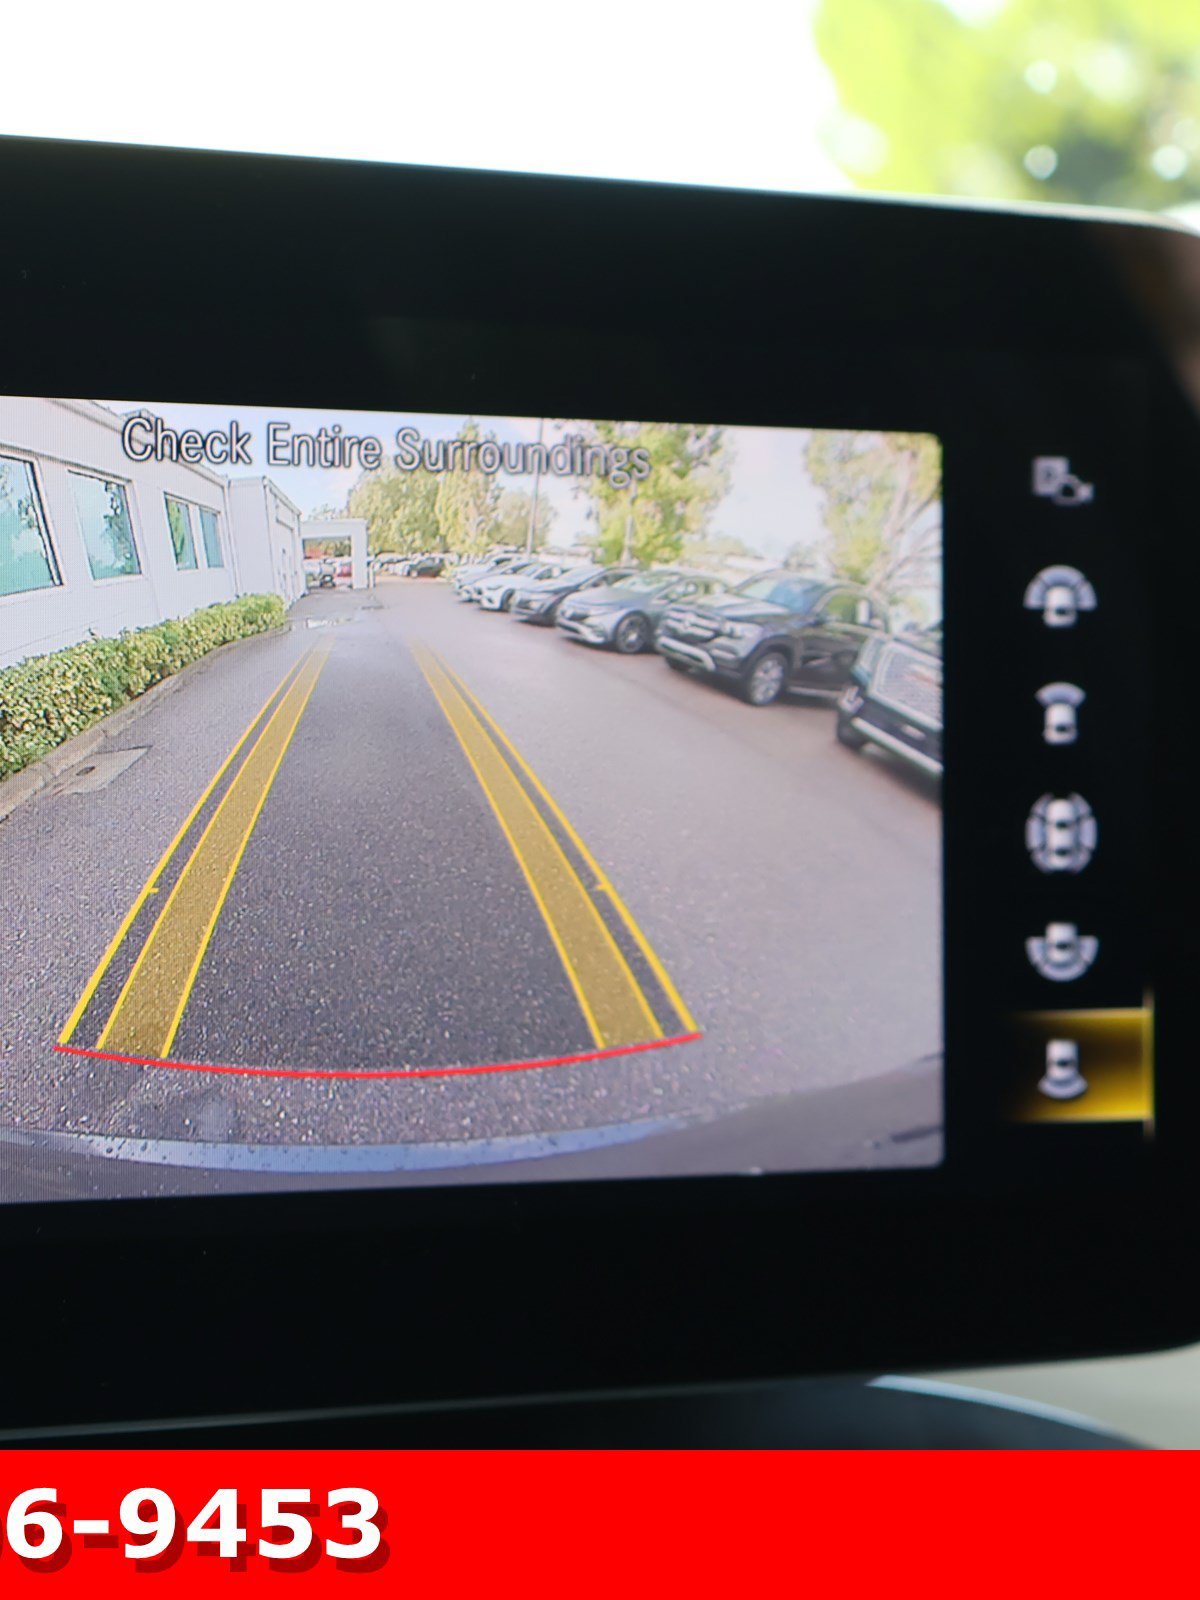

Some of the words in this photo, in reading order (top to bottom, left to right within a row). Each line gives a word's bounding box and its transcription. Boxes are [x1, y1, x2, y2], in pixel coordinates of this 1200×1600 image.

[121, 416, 252, 466] Check
[266, 421, 383, 470] Entire
[394, 427, 652, 490] Surroundings
